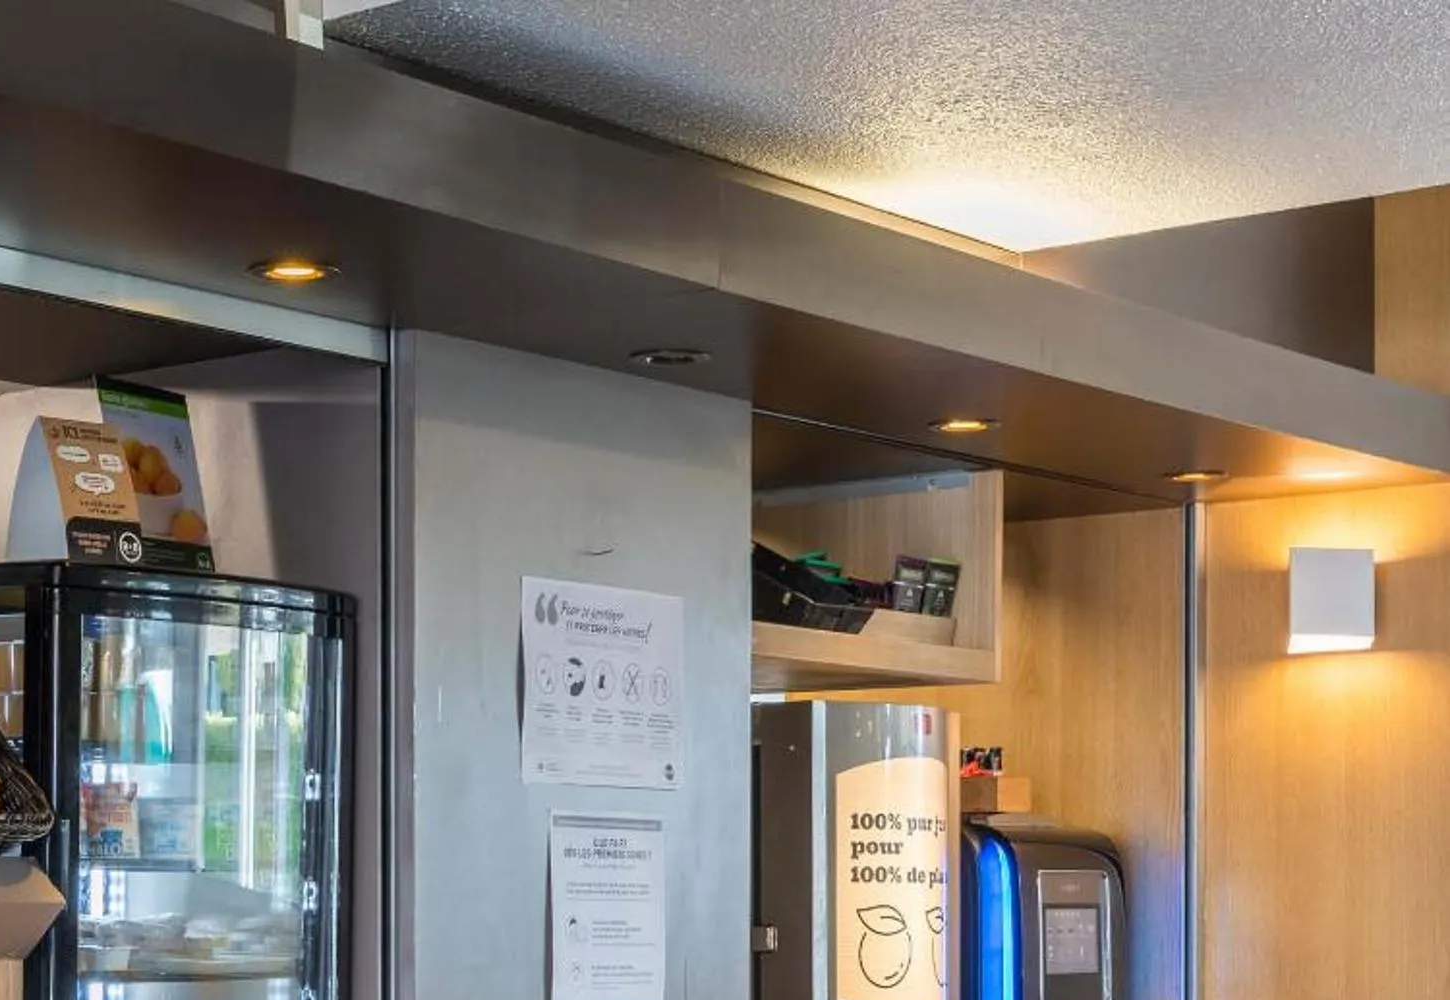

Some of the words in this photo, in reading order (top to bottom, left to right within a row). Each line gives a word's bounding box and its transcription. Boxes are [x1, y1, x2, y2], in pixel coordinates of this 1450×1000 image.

[850, 813, 902, 831] 100%
[907, 817, 933, 836] pur
[850, 841, 903, 860] pour
[850, 866, 902, 883] 100%
[907, 867, 926, 884] de
